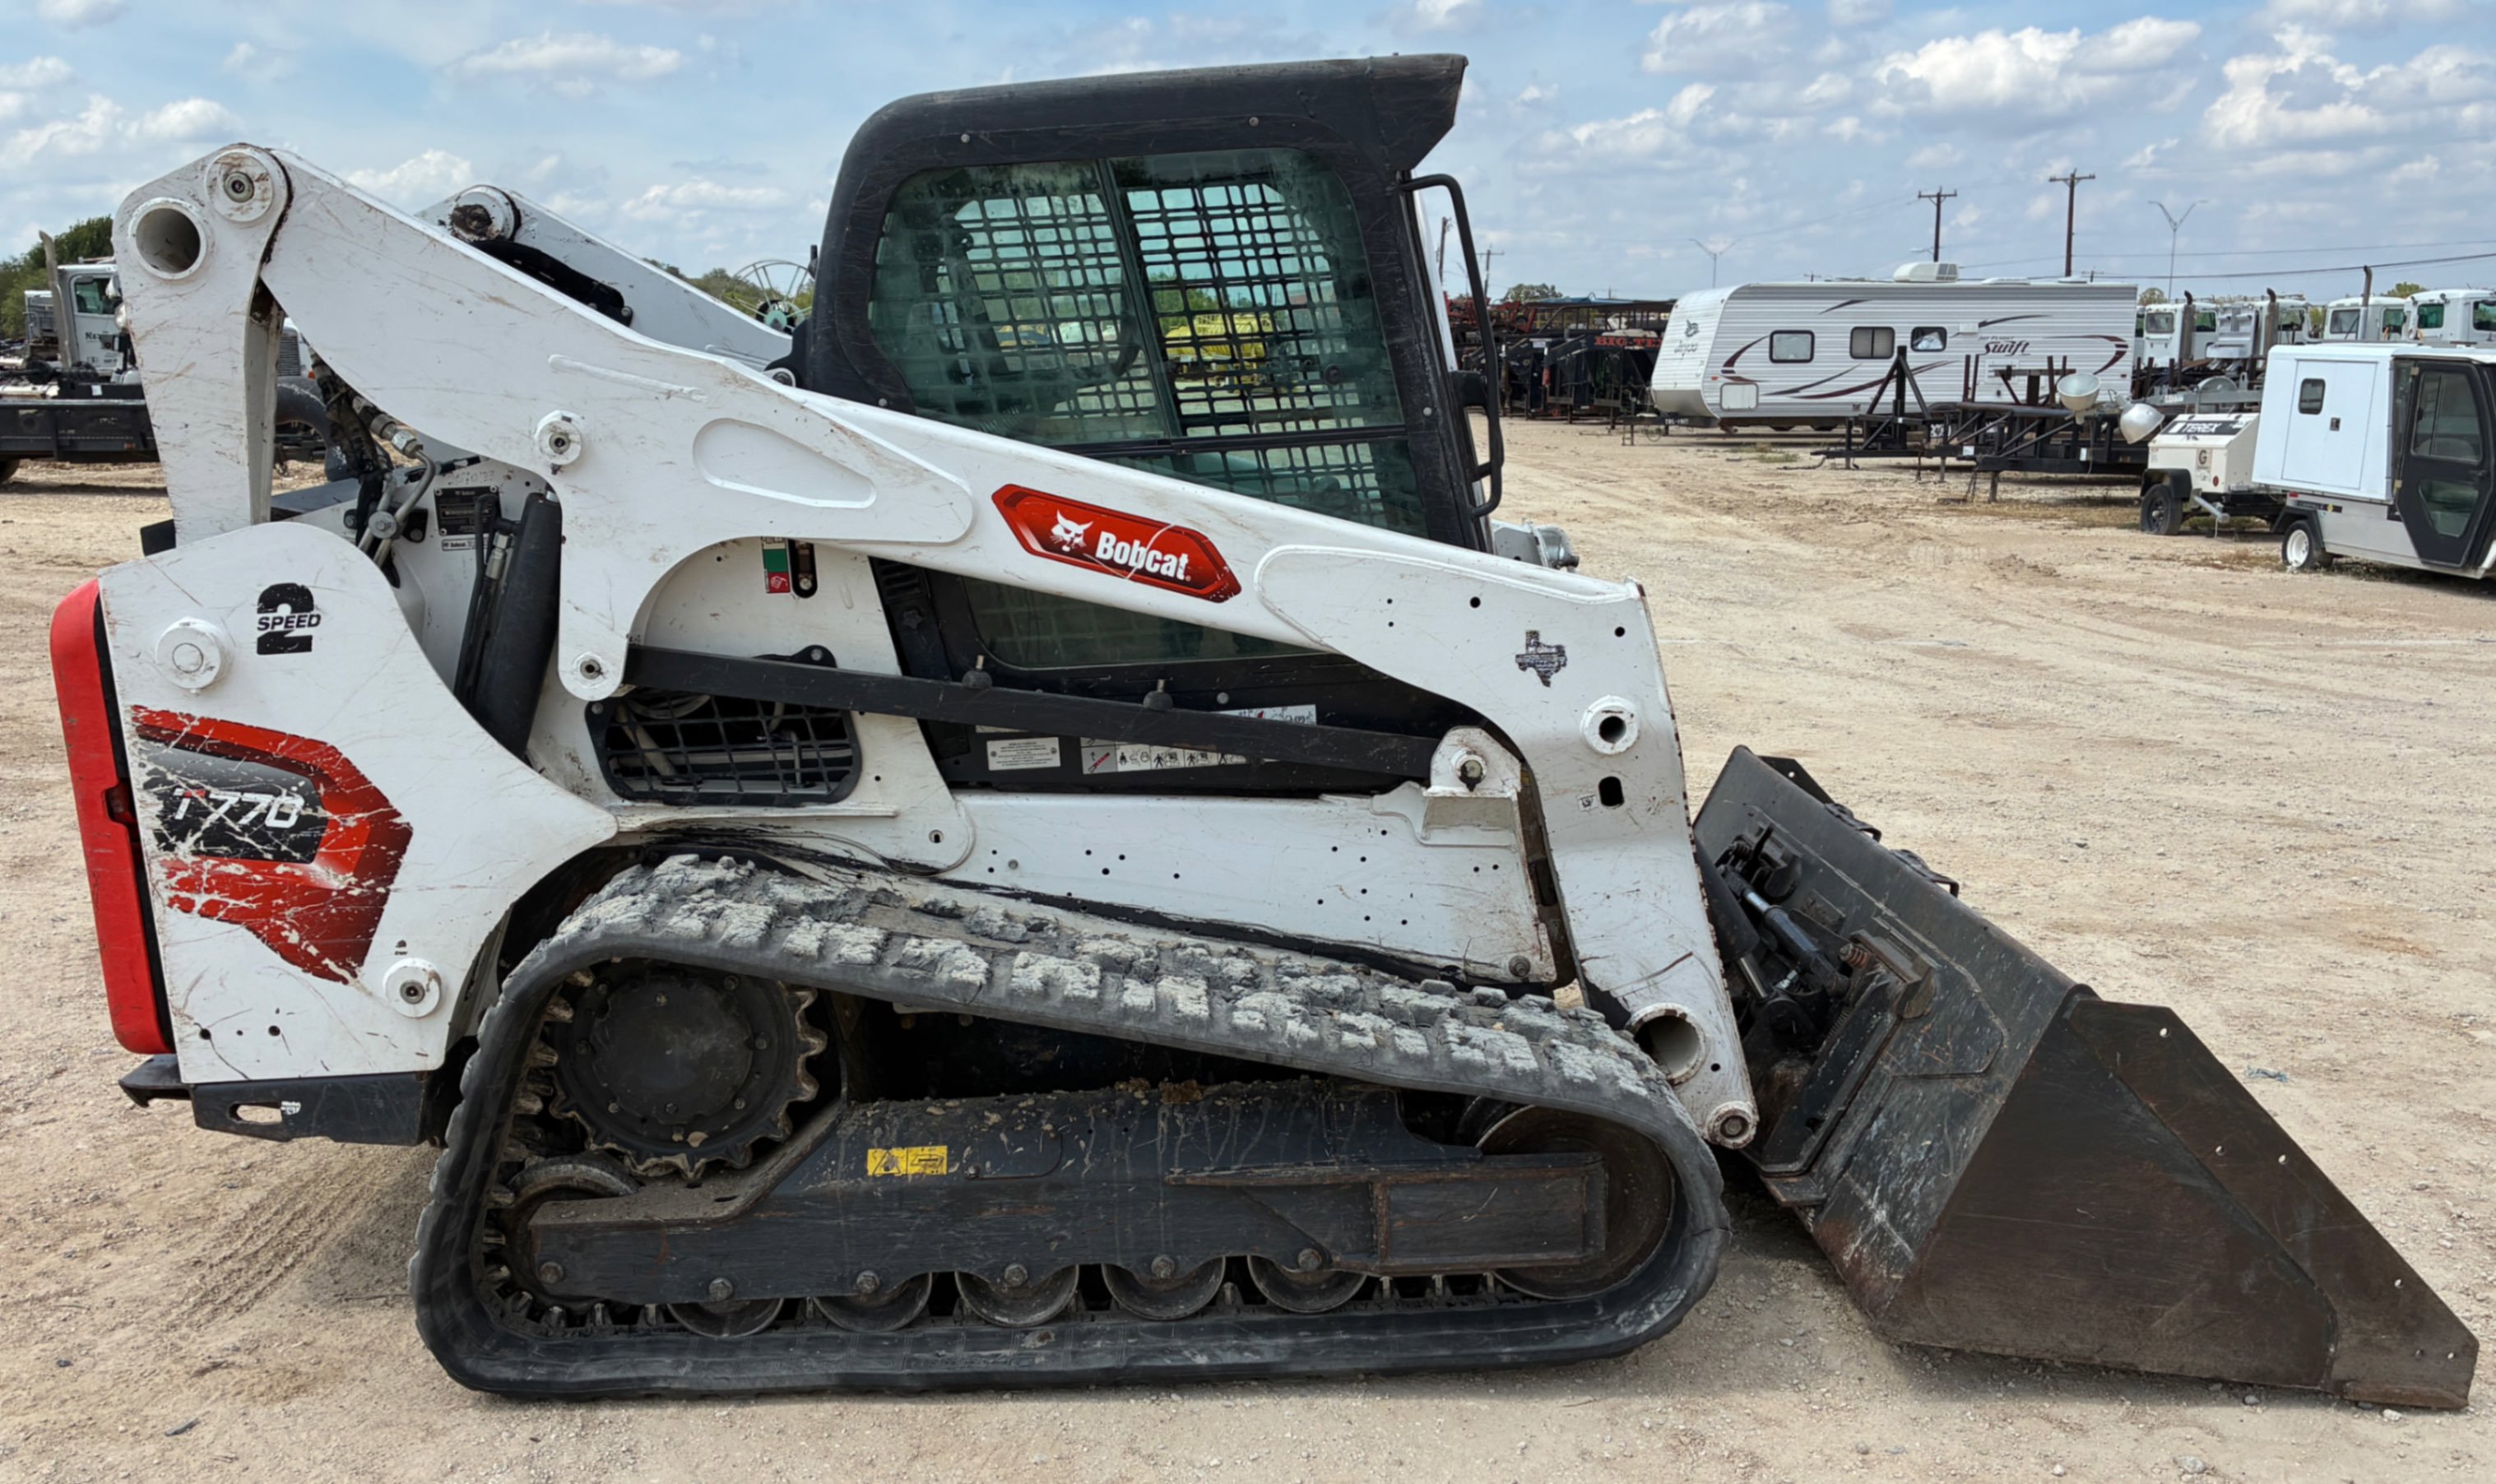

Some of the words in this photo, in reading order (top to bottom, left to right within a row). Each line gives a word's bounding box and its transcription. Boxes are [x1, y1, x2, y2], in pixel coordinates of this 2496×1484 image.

[1979, 340, 2030, 356] Swift
[1095, 531, 1190, 581] Bobcat
[257, 614, 322, 632] SPEED
[173, 787, 305, 828] T770
